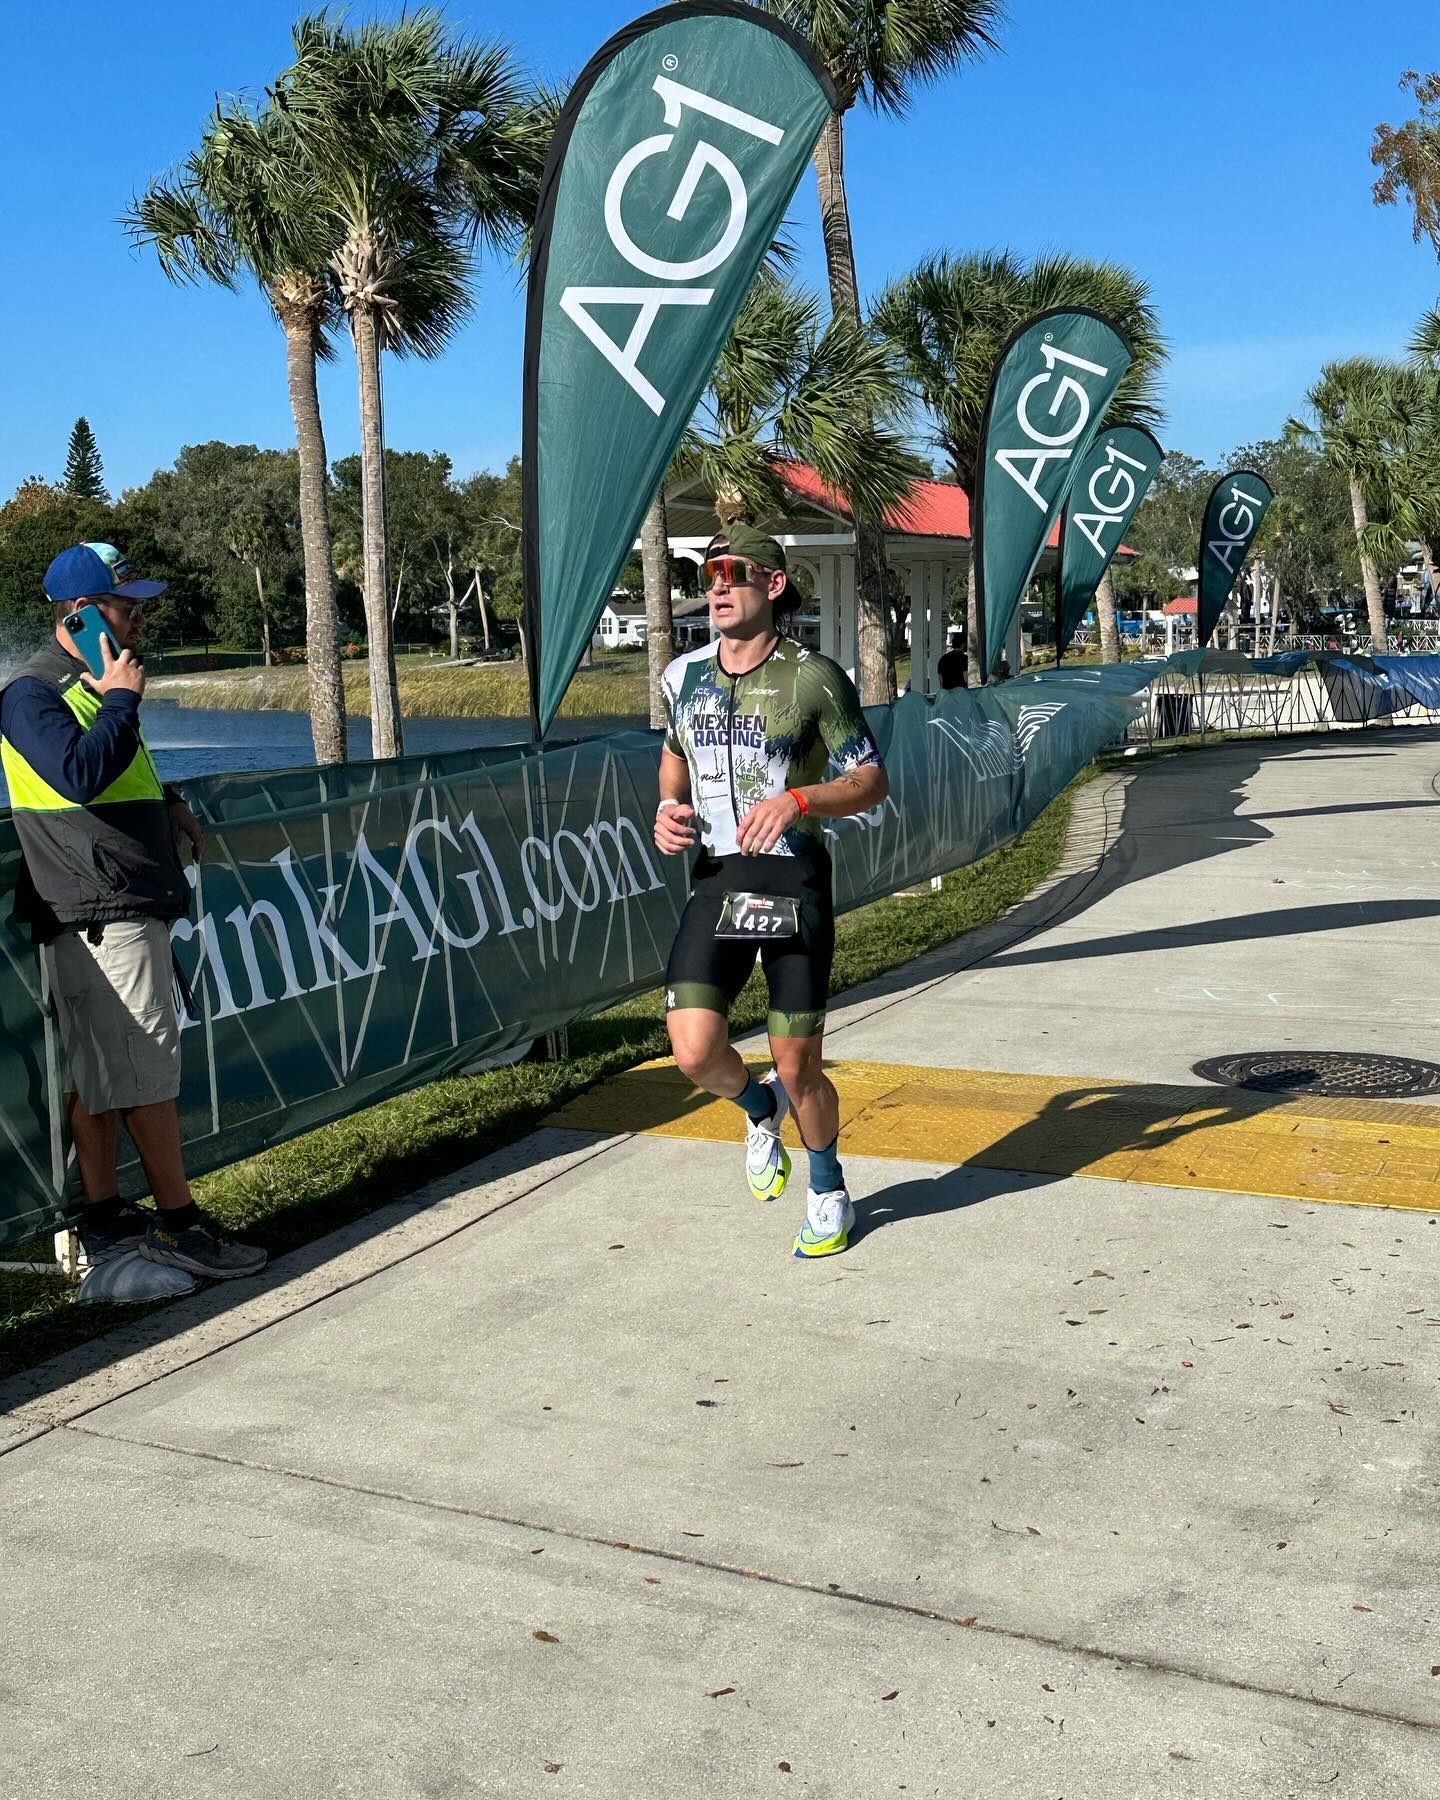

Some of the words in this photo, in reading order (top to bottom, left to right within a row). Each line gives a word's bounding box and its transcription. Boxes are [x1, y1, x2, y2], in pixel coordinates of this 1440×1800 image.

[1207, 486, 1262, 574] AG1
[693, 730, 763, 749] RACING
[170, 810, 666, 1031] rinkAG1.com
[735, 912, 783, 933] 1427
